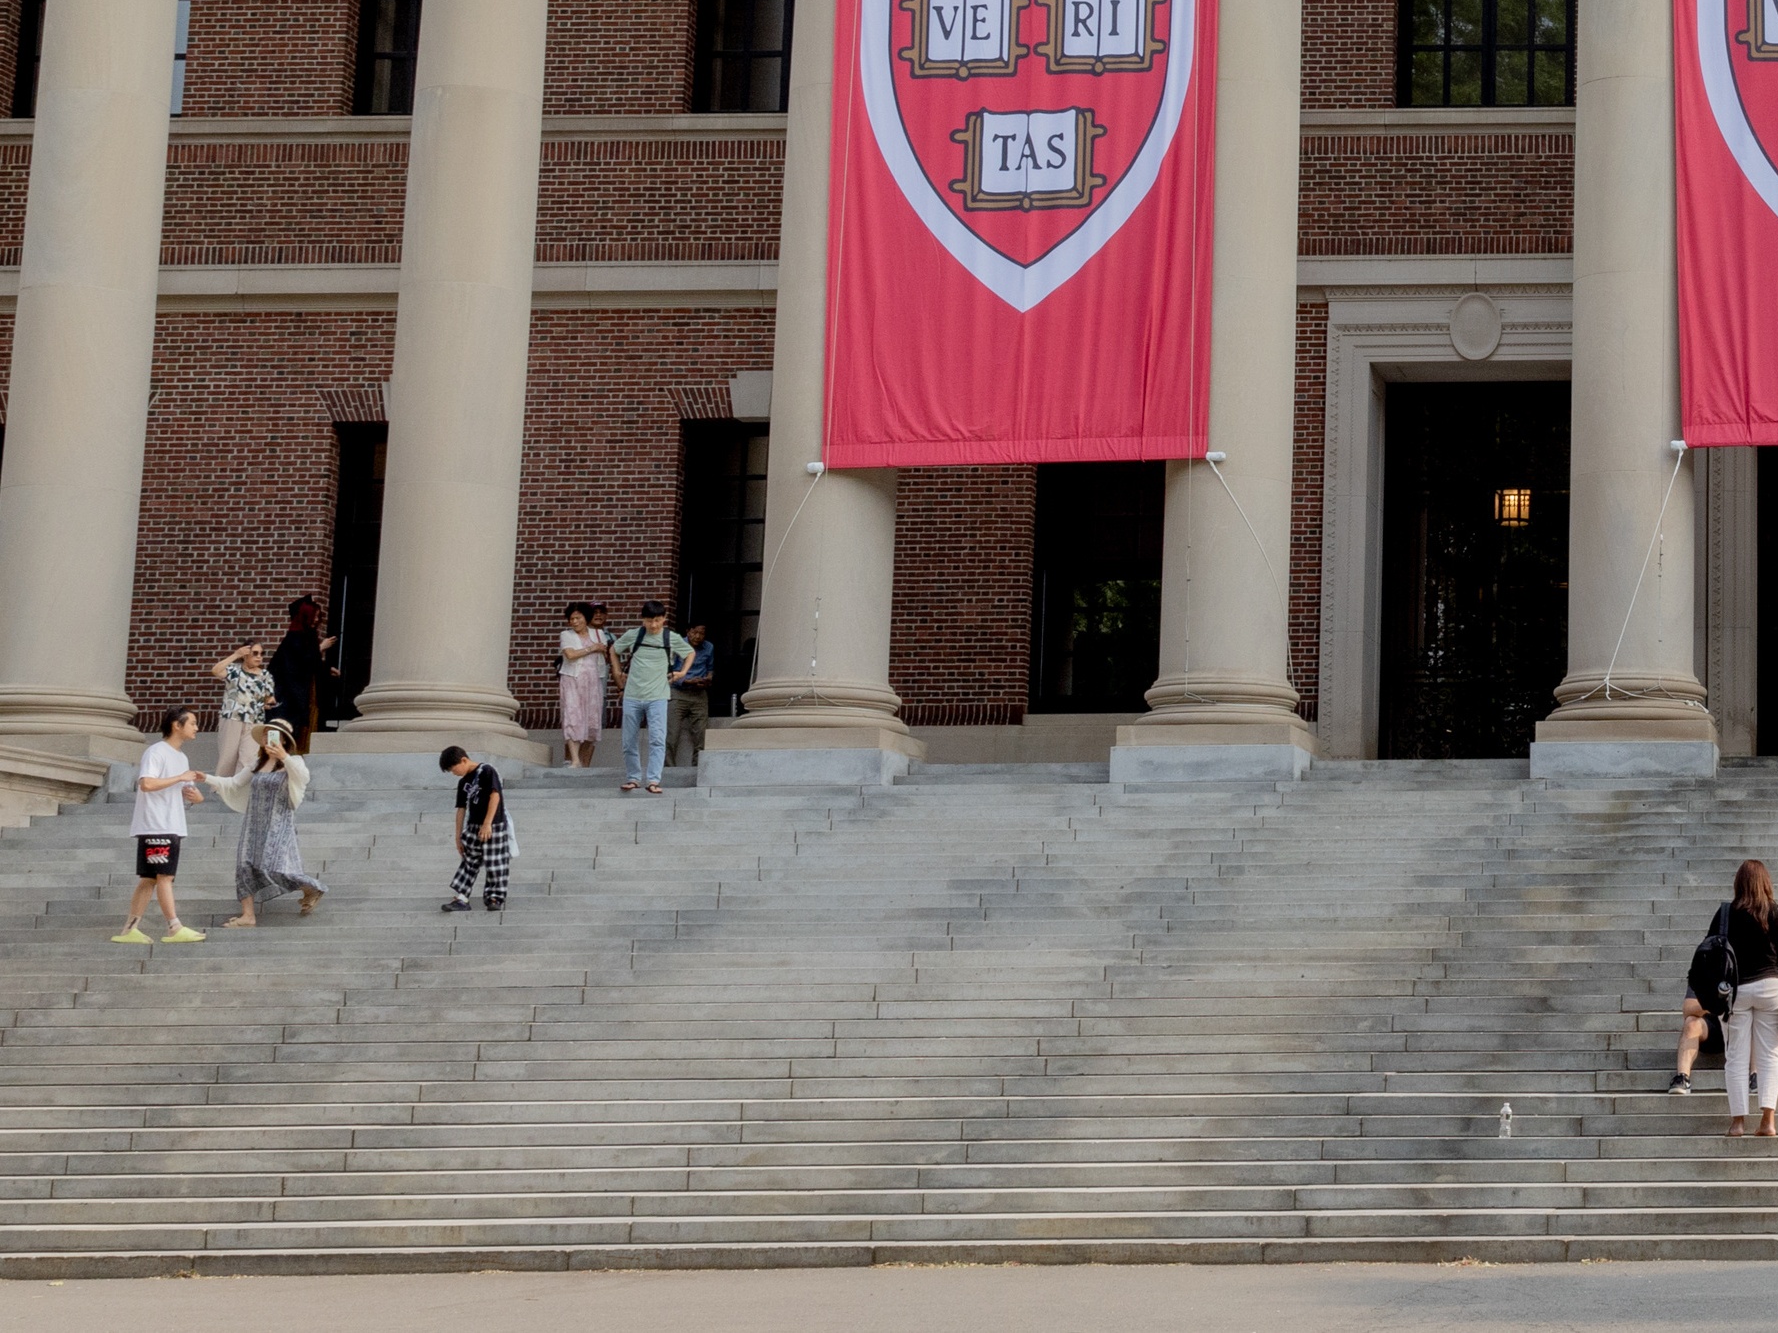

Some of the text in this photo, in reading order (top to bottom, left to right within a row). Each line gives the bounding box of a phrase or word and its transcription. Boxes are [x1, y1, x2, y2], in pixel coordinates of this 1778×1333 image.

[931, 0, 1121, 41] VE RI
[991, 132, 1067, 171] TAS
